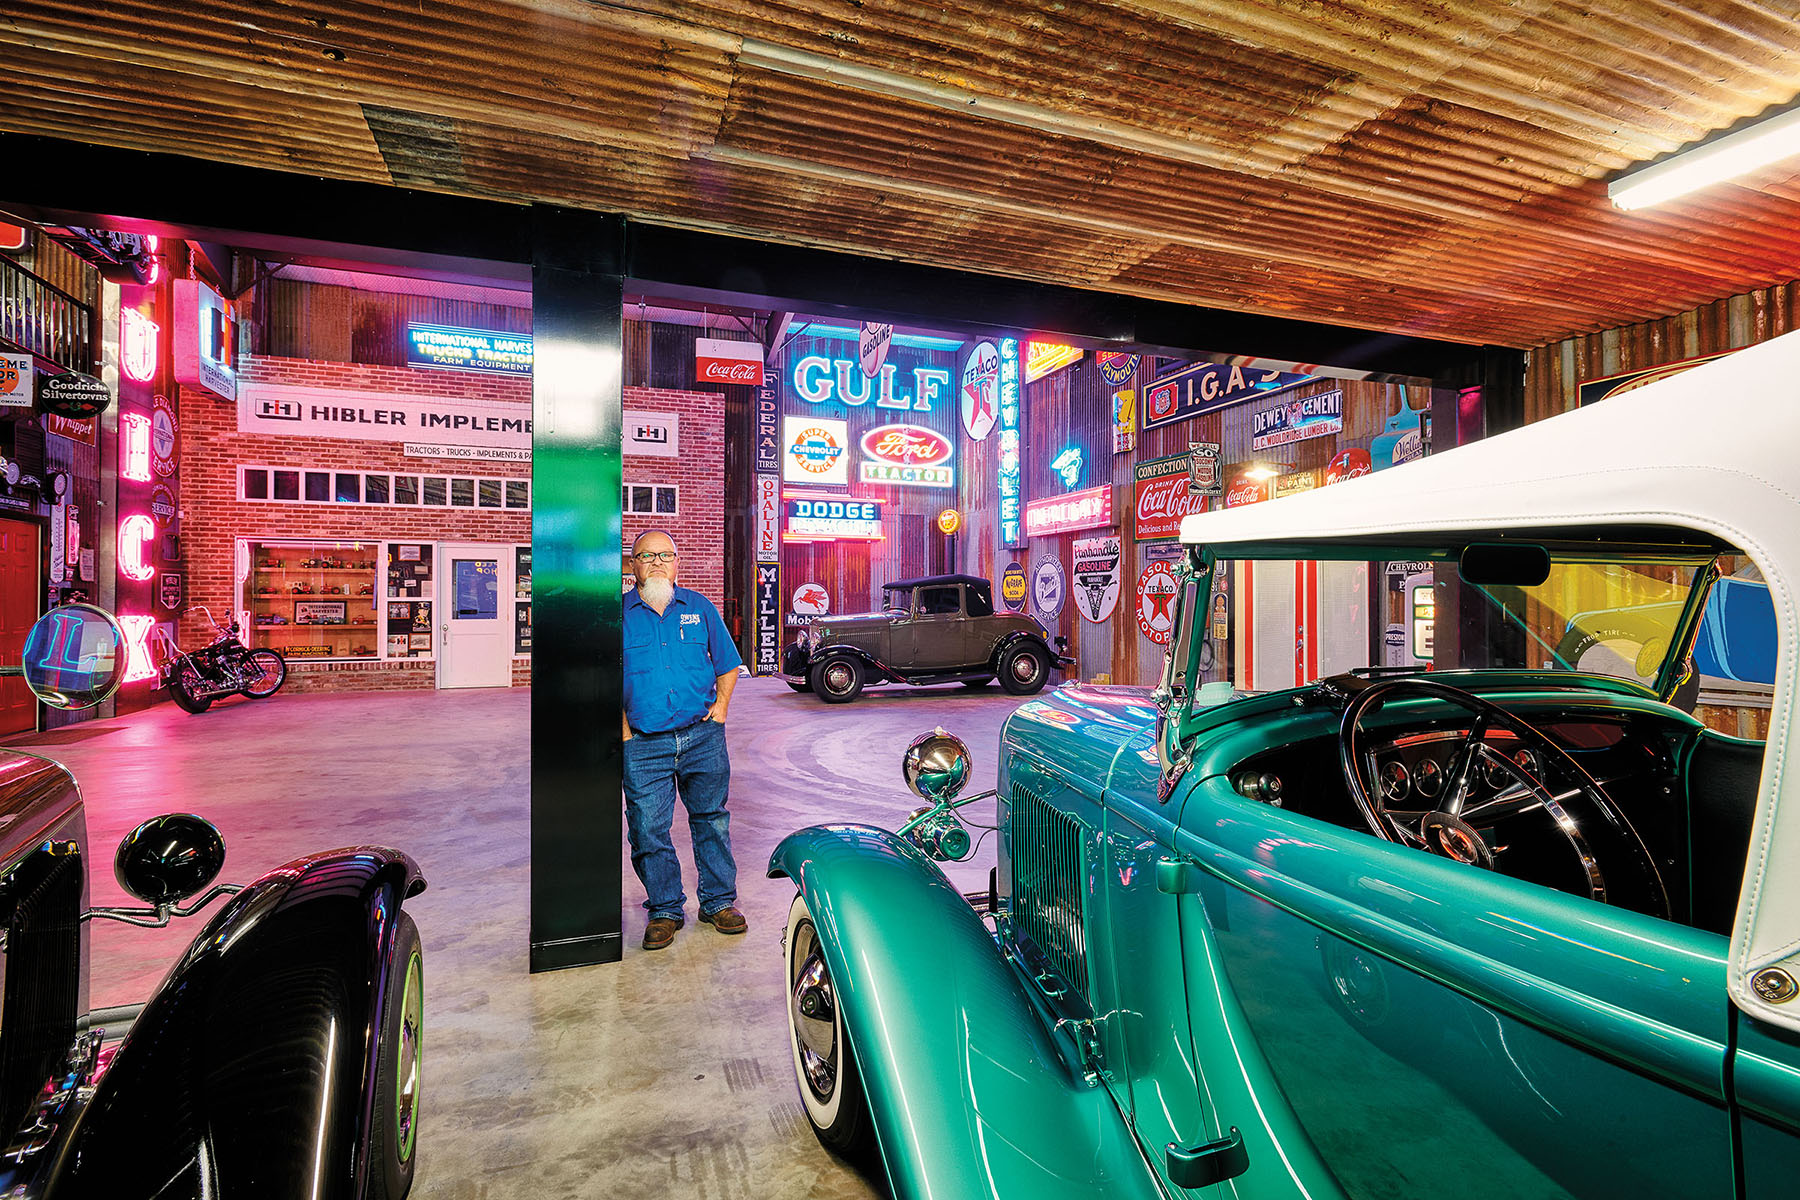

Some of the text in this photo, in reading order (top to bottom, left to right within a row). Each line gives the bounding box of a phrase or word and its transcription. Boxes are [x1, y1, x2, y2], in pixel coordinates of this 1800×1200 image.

[413, 331, 490, 349] INTERNATIONAL
[862, 324, 891, 358] GASOLINE
[417, 343, 472, 359] TRUCKS
[433, 356, 531, 371] FARM EQUIPMENT
[706, 361, 756, 381] Coca-Cola
[965, 355, 998, 384] TEXACO
[48, 379, 107, 391] Goodrich
[794, 356, 949, 411] GULF
[1188, 366, 1255, 406] I.G.A.
[42, 388, 108, 401] Silvertowns
[160, 399, 179, 432] DIAMOND
[311, 405, 407, 426] HIBLER
[760, 372, 778, 460] FEDERAL
[1254, 392, 1341, 434] DEWEY CEMENT
[802, 428, 832, 441] SUPER
[1001, 337, 1020, 546] CHEVROLET
[1266, 428, 1302, 446] WOOLDRIDGE
[1303, 422, 1329, 438] LUMBER
[405, 445, 441, 455] TRACTORS
[446, 448, 472, 457] TRUCKS
[476, 450, 517, 459] IMPLEMENTS
[793, 444, 840, 456] CHEVROLET
[875, 432, 939, 459] Ford
[153, 457, 175, 474] ERVICE
[758, 460, 778, 468] TIRES
[797, 456, 835, 473] SERVICE
[1138, 459, 1188, 479] CONFECTION
[866, 466, 948, 483] TRACTOR
[1287, 477, 1313, 489] PAINT
[1154, 480, 1175, 489] DRINK
[1227, 486, 1260, 506] Coca-Cola
[762, 480, 775, 551] OPALINE
[796, 501, 875, 520] DODGE
[1138, 525, 1162, 534] Delicious
[1162, 521, 1173, 532] and
[1077, 560, 1112, 573] GASOLINE
[1148, 585, 1174, 593] TEXACO
[760, 567, 777, 662] MILLER
[757, 663, 779, 673] TIRES
